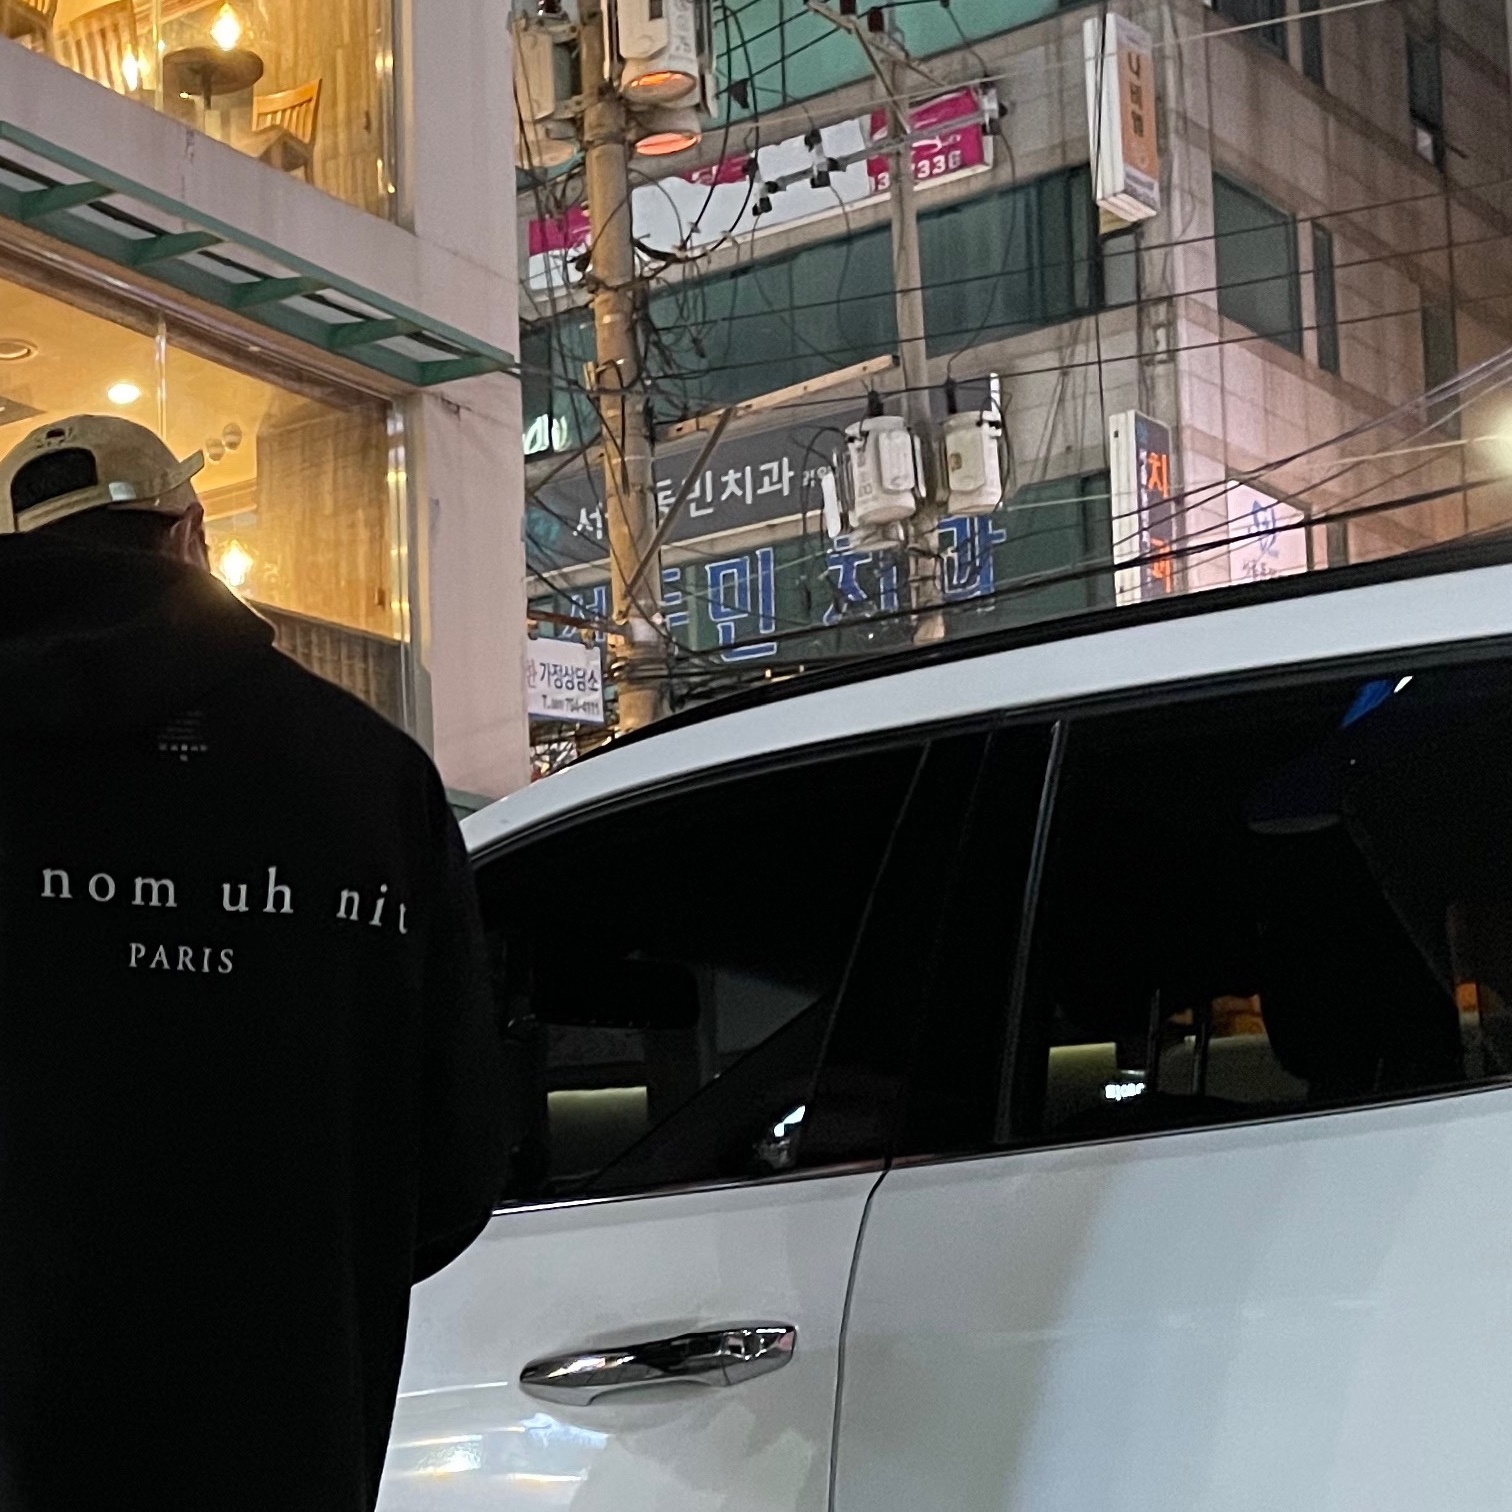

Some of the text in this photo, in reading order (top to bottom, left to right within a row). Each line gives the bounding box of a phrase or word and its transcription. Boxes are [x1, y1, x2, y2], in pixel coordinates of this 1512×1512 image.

[41, 868, 177, 908] nom
[222, 866, 294, 914] uh
[128, 943, 234, 973] PARIS
